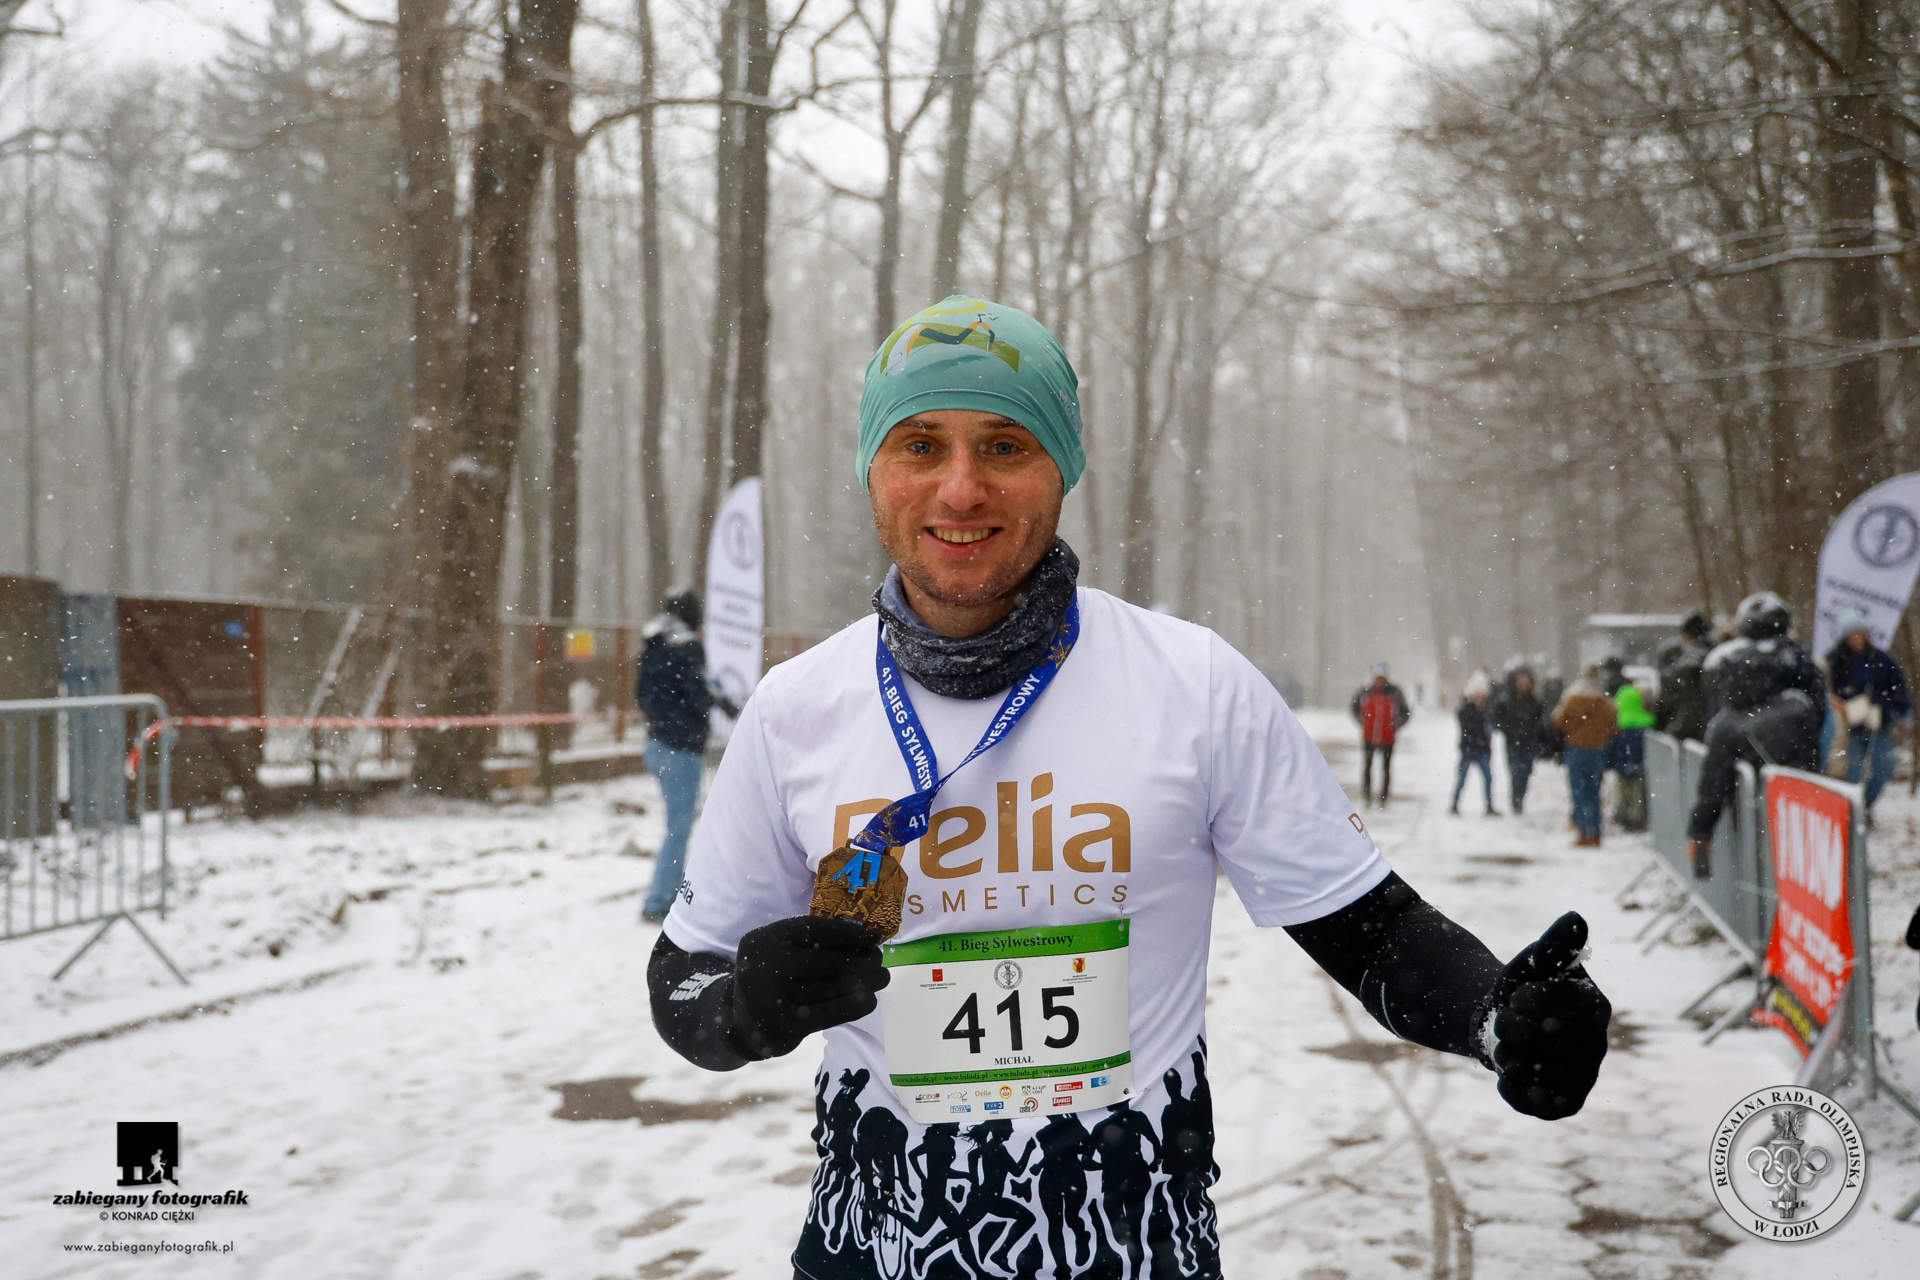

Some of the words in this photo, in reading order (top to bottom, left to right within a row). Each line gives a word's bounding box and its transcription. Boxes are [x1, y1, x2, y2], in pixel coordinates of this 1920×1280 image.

[901, 726, 932, 791] SYLWESTR
[832, 851, 882, 893] 41
[680, 878, 694, 905] elia
[908, 884, 1128, 915] SMETICS
[939, 940, 958, 952] 41.
[961, 938, 989, 953] Bieg
[992, 934, 1075, 952] Sylwestrowy
[942, 986, 1080, 1054] 415
[994, 1055, 1034, 1066] MICHAŁ
